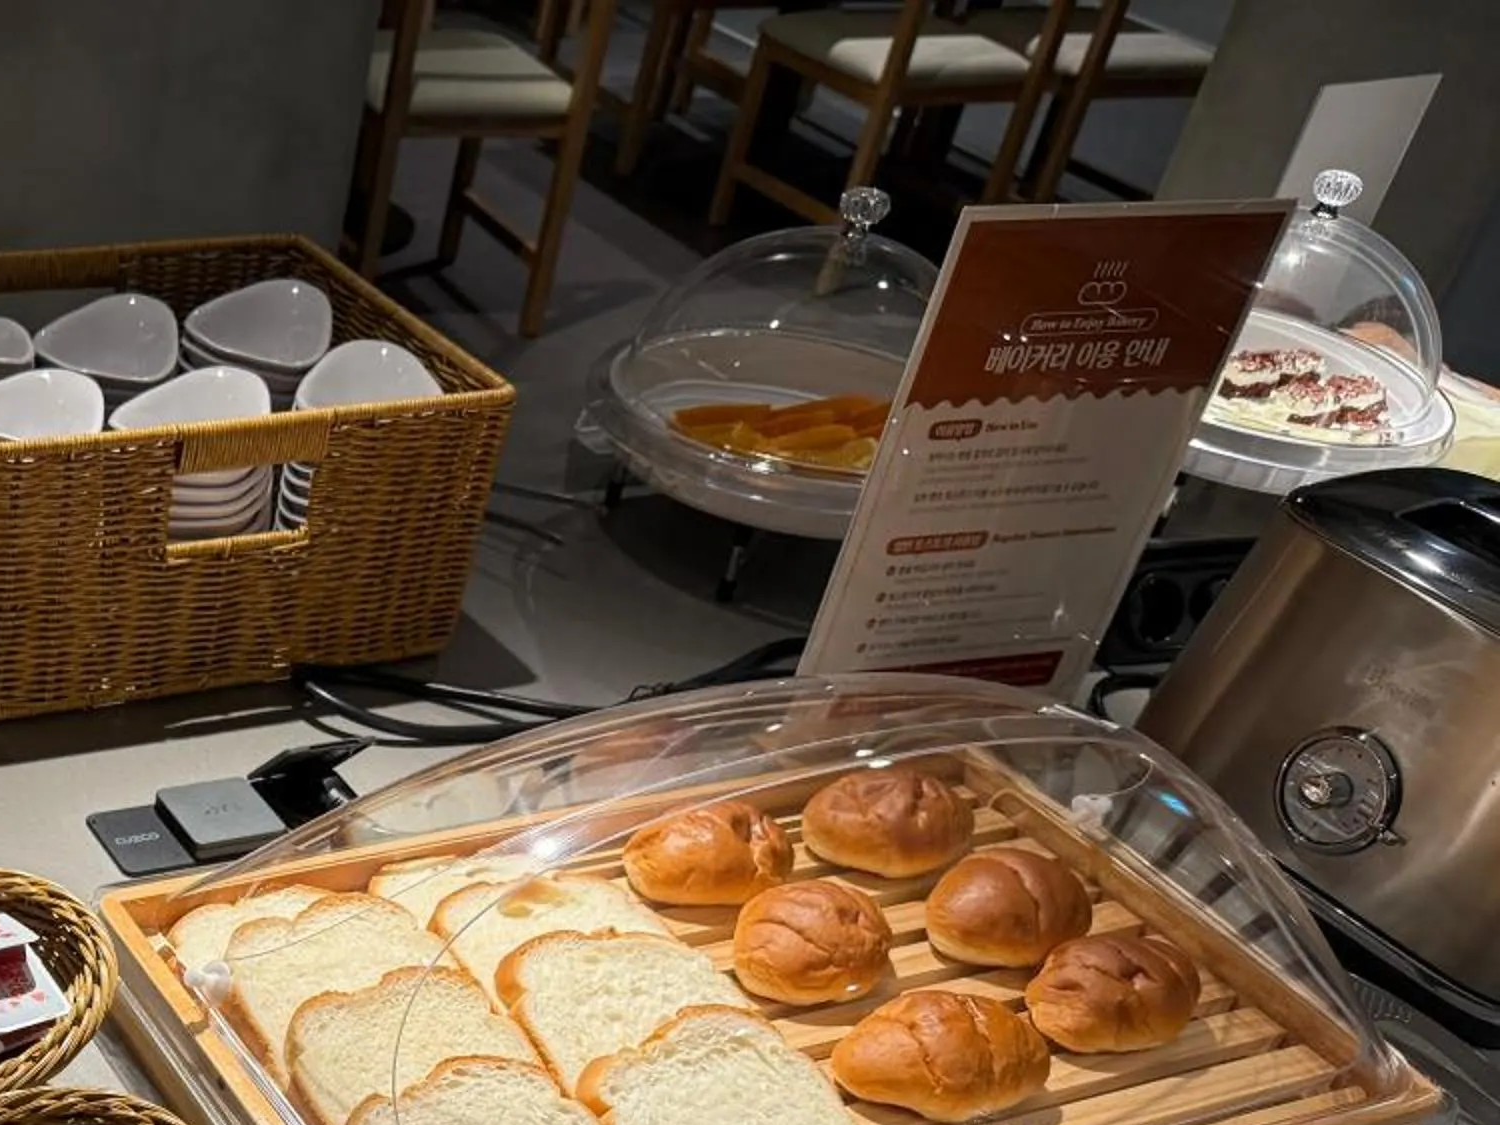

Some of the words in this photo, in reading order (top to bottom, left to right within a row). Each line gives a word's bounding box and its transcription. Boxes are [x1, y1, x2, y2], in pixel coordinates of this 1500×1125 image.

[984, 341, 1075, 374] 베이커리
[1076, 340, 1119, 370] 이용
[1123, 336, 1171, 368] 안내
